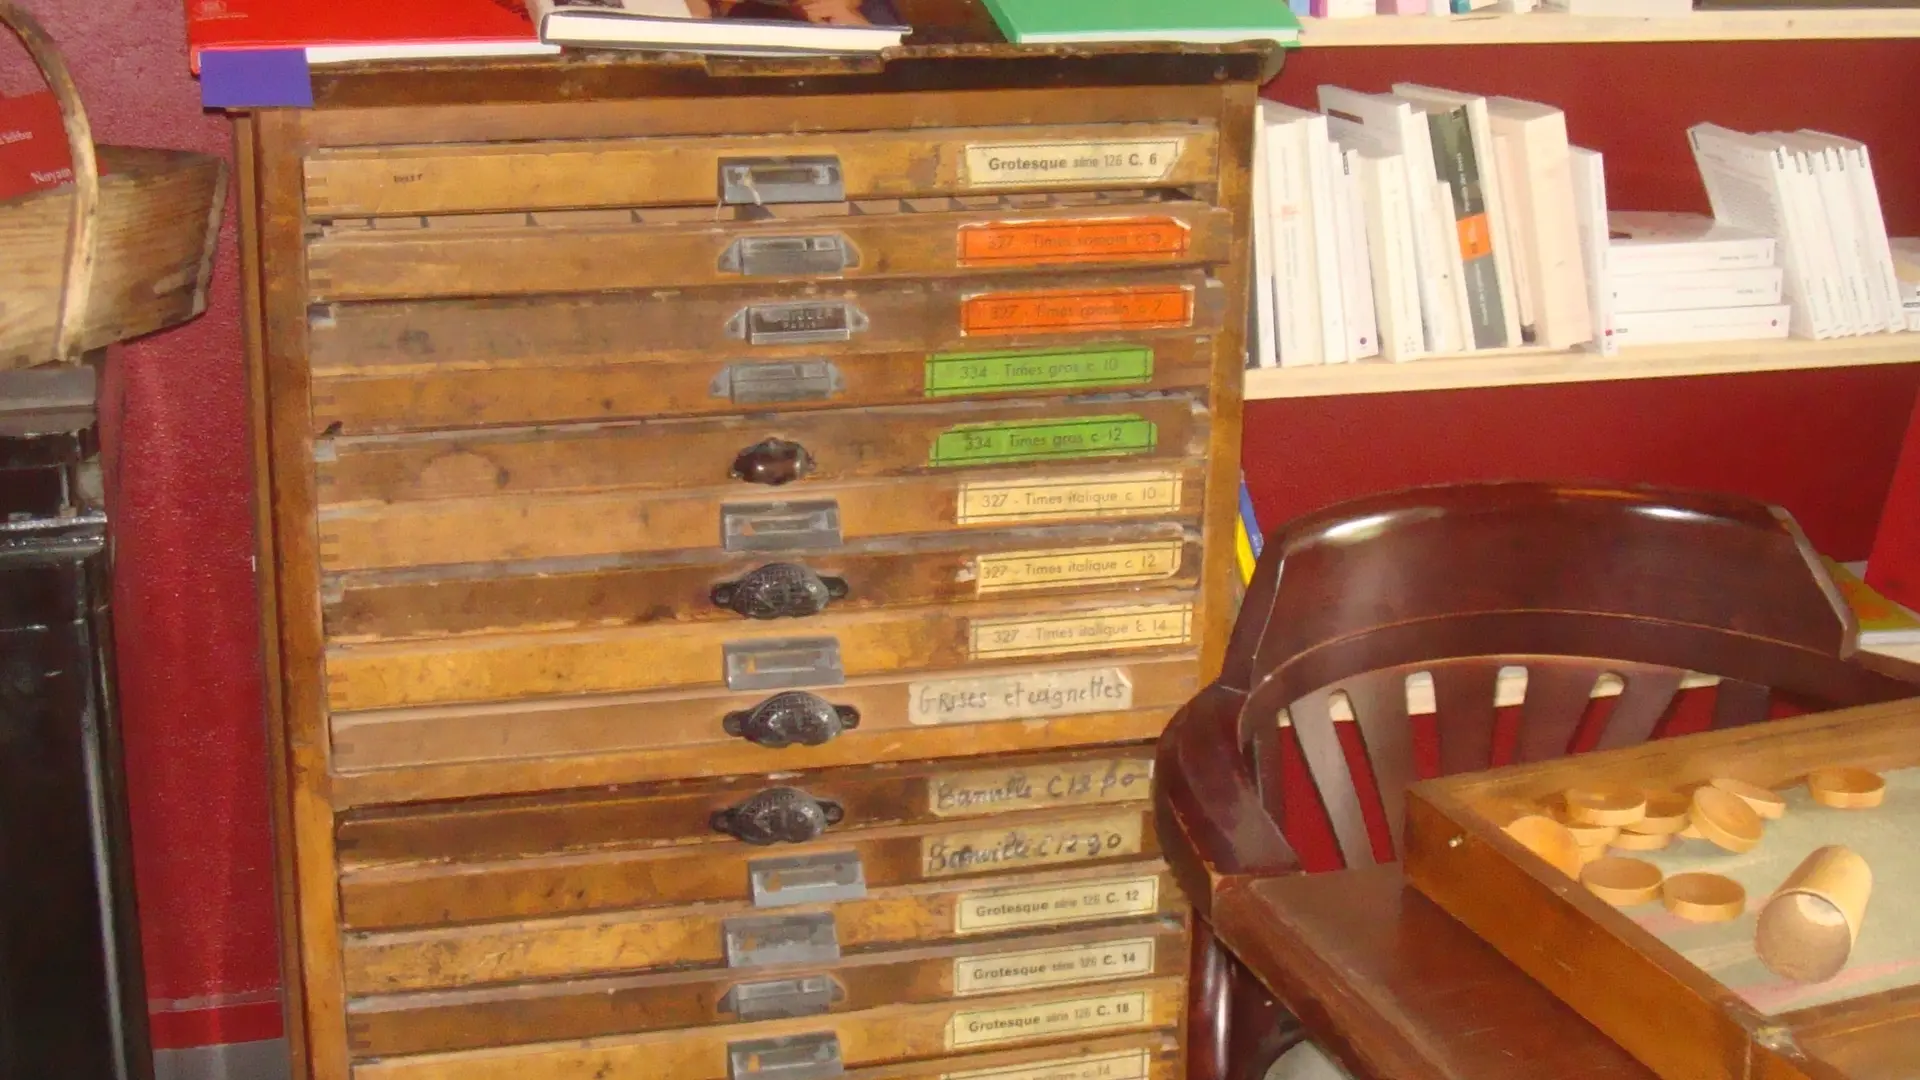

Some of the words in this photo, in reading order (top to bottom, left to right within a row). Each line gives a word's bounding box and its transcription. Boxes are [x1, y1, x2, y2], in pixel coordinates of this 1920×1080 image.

[988, 157, 1067, 171] Grotesque
[1128, 153, 1143, 166] C.
[1149, 152, 1157, 165] 6
[960, 366, 988, 380] 334
[1004, 362, 1043, 378] Times
[1049, 362, 1079, 378] gros
[1102, 358, 1119, 372] 10
[963, 435, 992, 451] 334
[1009, 433, 1047, 449] Times
[1053, 433, 1084, 449] gros
[1107, 428, 1122, 442] 12
[982, 494, 1008, 509] 327
[1025, 492, 1063, 506] Times
[1068, 491, 1118, 507] italique
[1143, 486, 1157, 501] 10
[983, 565, 1008, 580] 327
[1025, 562, 1062, 576] Times
[1068, 560, 1118, 575] italique
[1142, 555, 1157, 569] 12
[992, 629, 1019, 644] 327
[1036, 627, 1074, 641] Times
[1153, 619, 1167, 632] 14
[976, 901, 1049, 917] Grotesque
[1105, 892, 1120, 905] C.
[1125, 889, 1140, 902] 12
[973, 963, 1047, 981] Grotesque
[1102, 954, 1117, 967] C.
[1122, 952, 1136, 965] 14
[968, 1014, 1041, 1033] Grotesque
[1096, 1005, 1111, 1017] C.
[1115, 1002, 1130, 1014] 18
